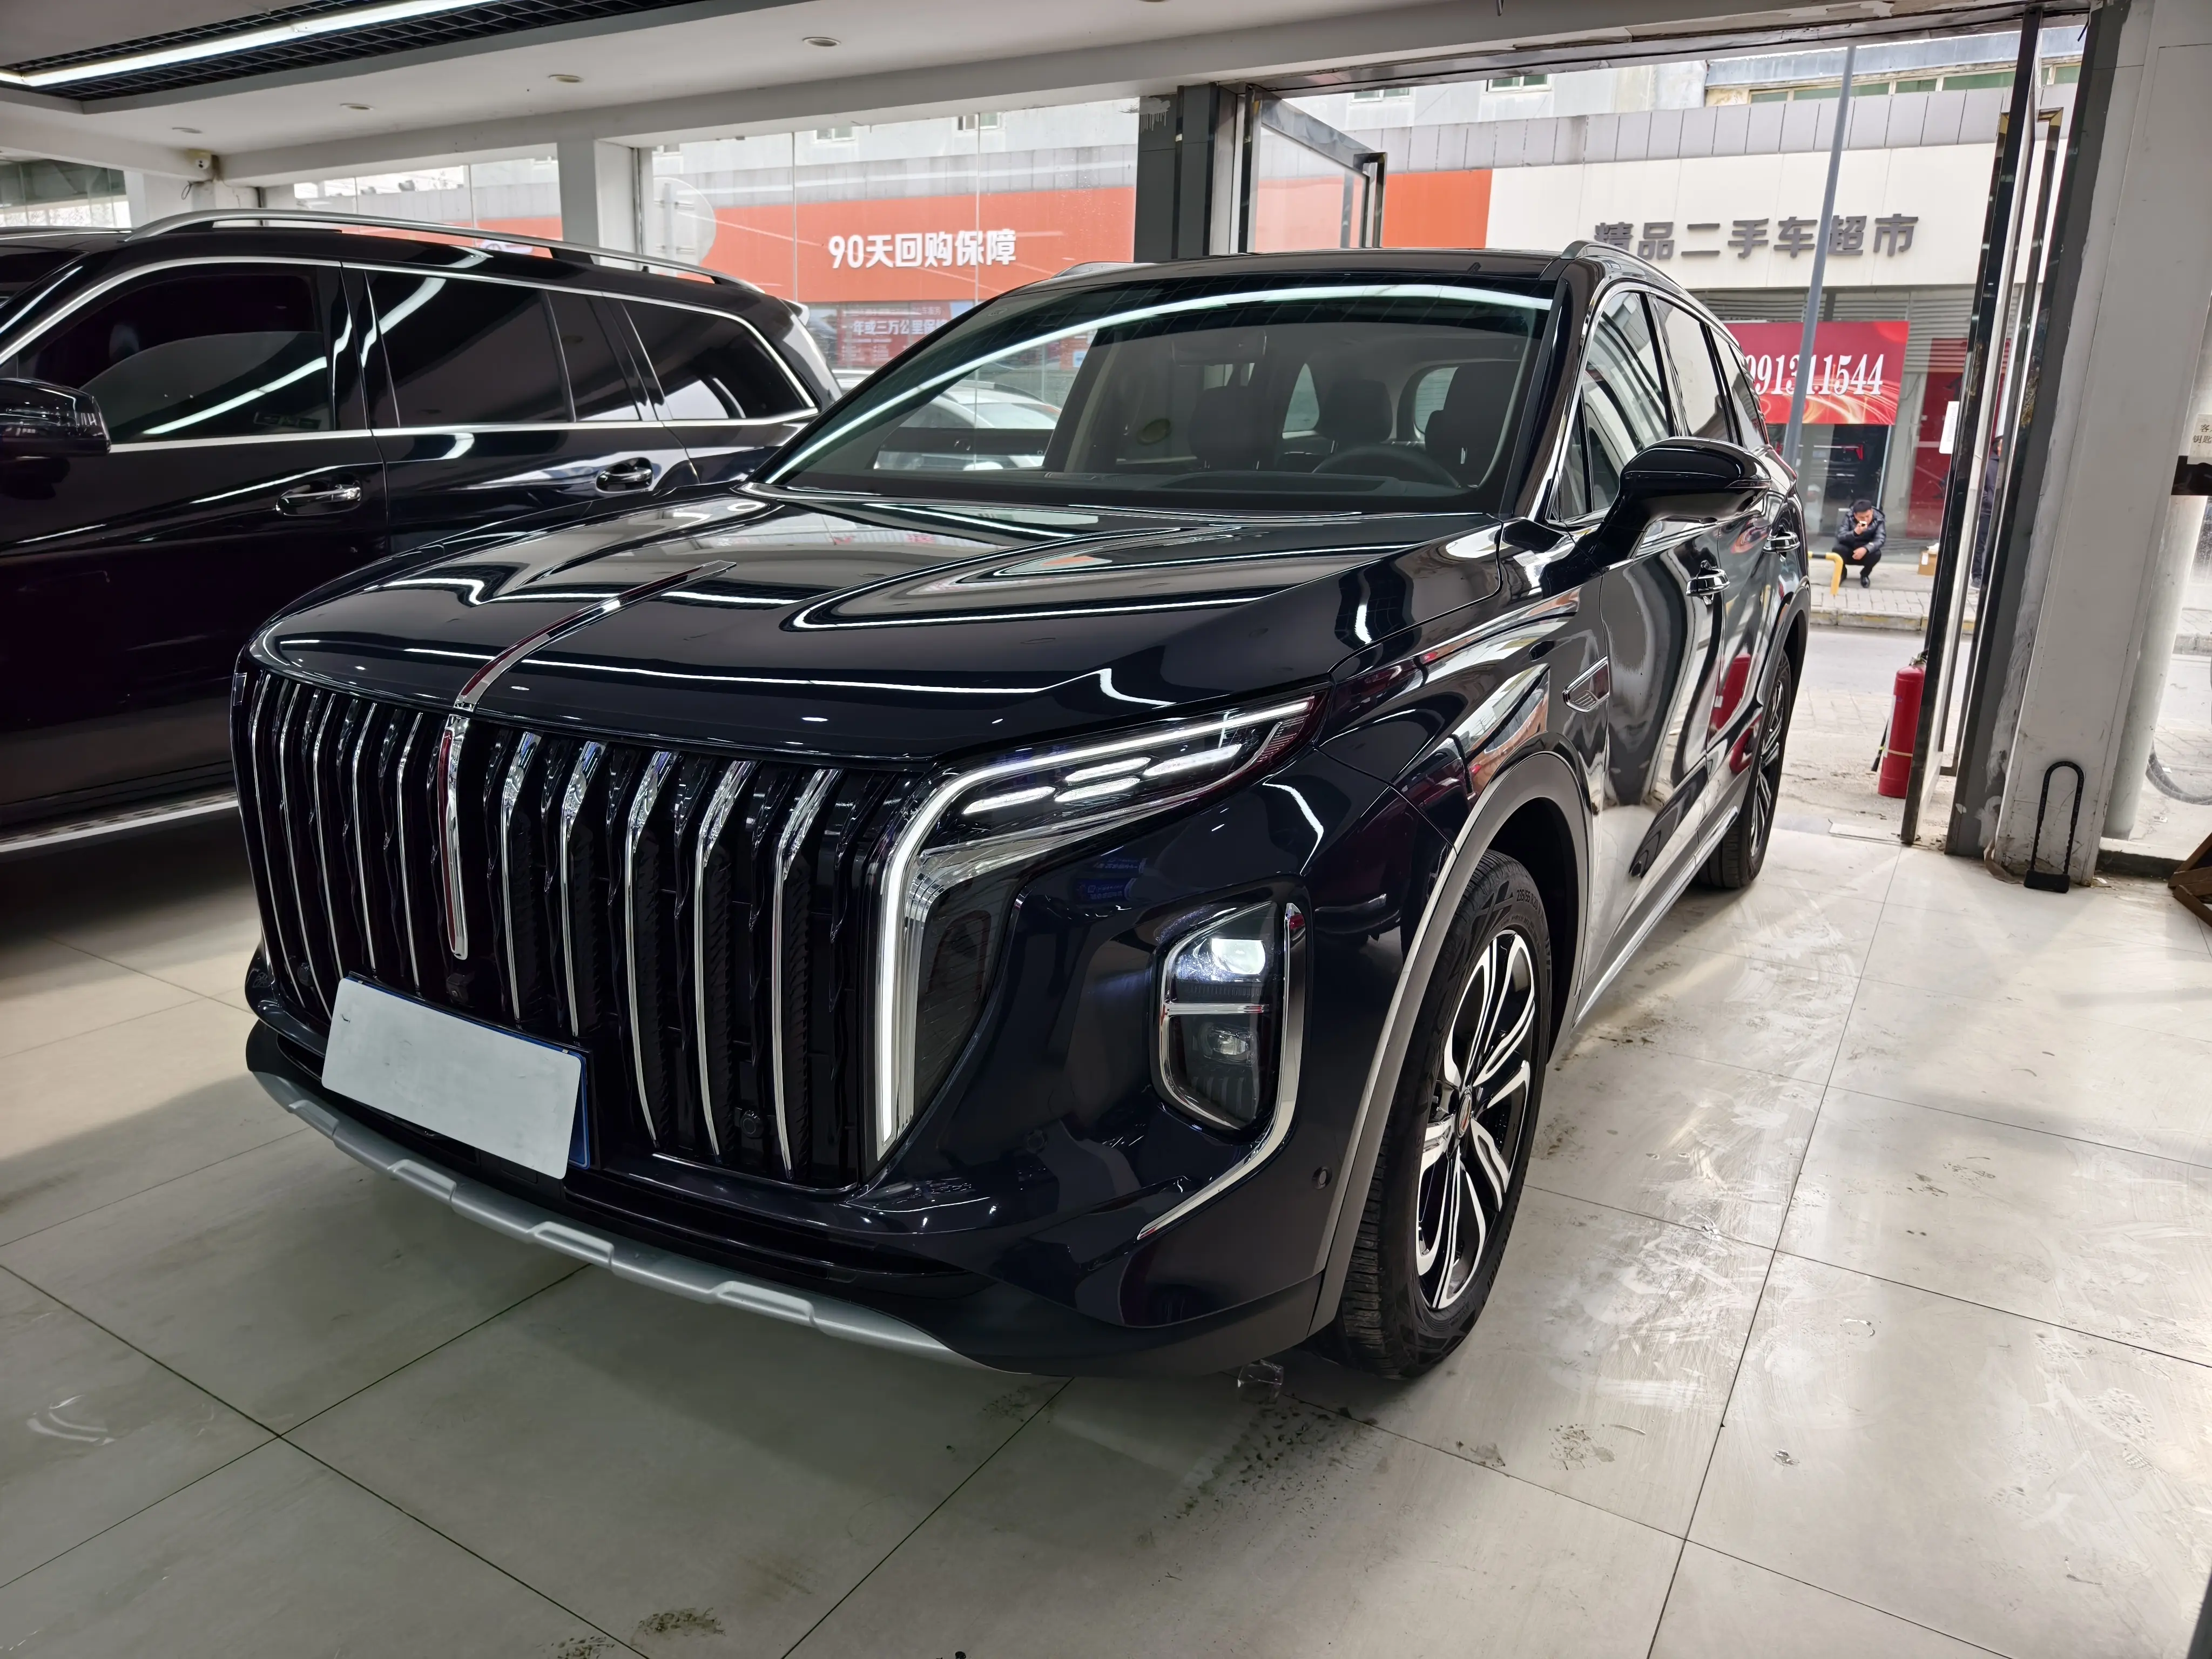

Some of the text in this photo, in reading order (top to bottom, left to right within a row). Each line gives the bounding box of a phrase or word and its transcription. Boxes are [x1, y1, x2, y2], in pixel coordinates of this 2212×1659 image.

[828, 228, 1016, 269] 90天回购保障
[1594, 213, 1918, 260] 精品二手车超市
[2200, 424, 2212, 433] 客
